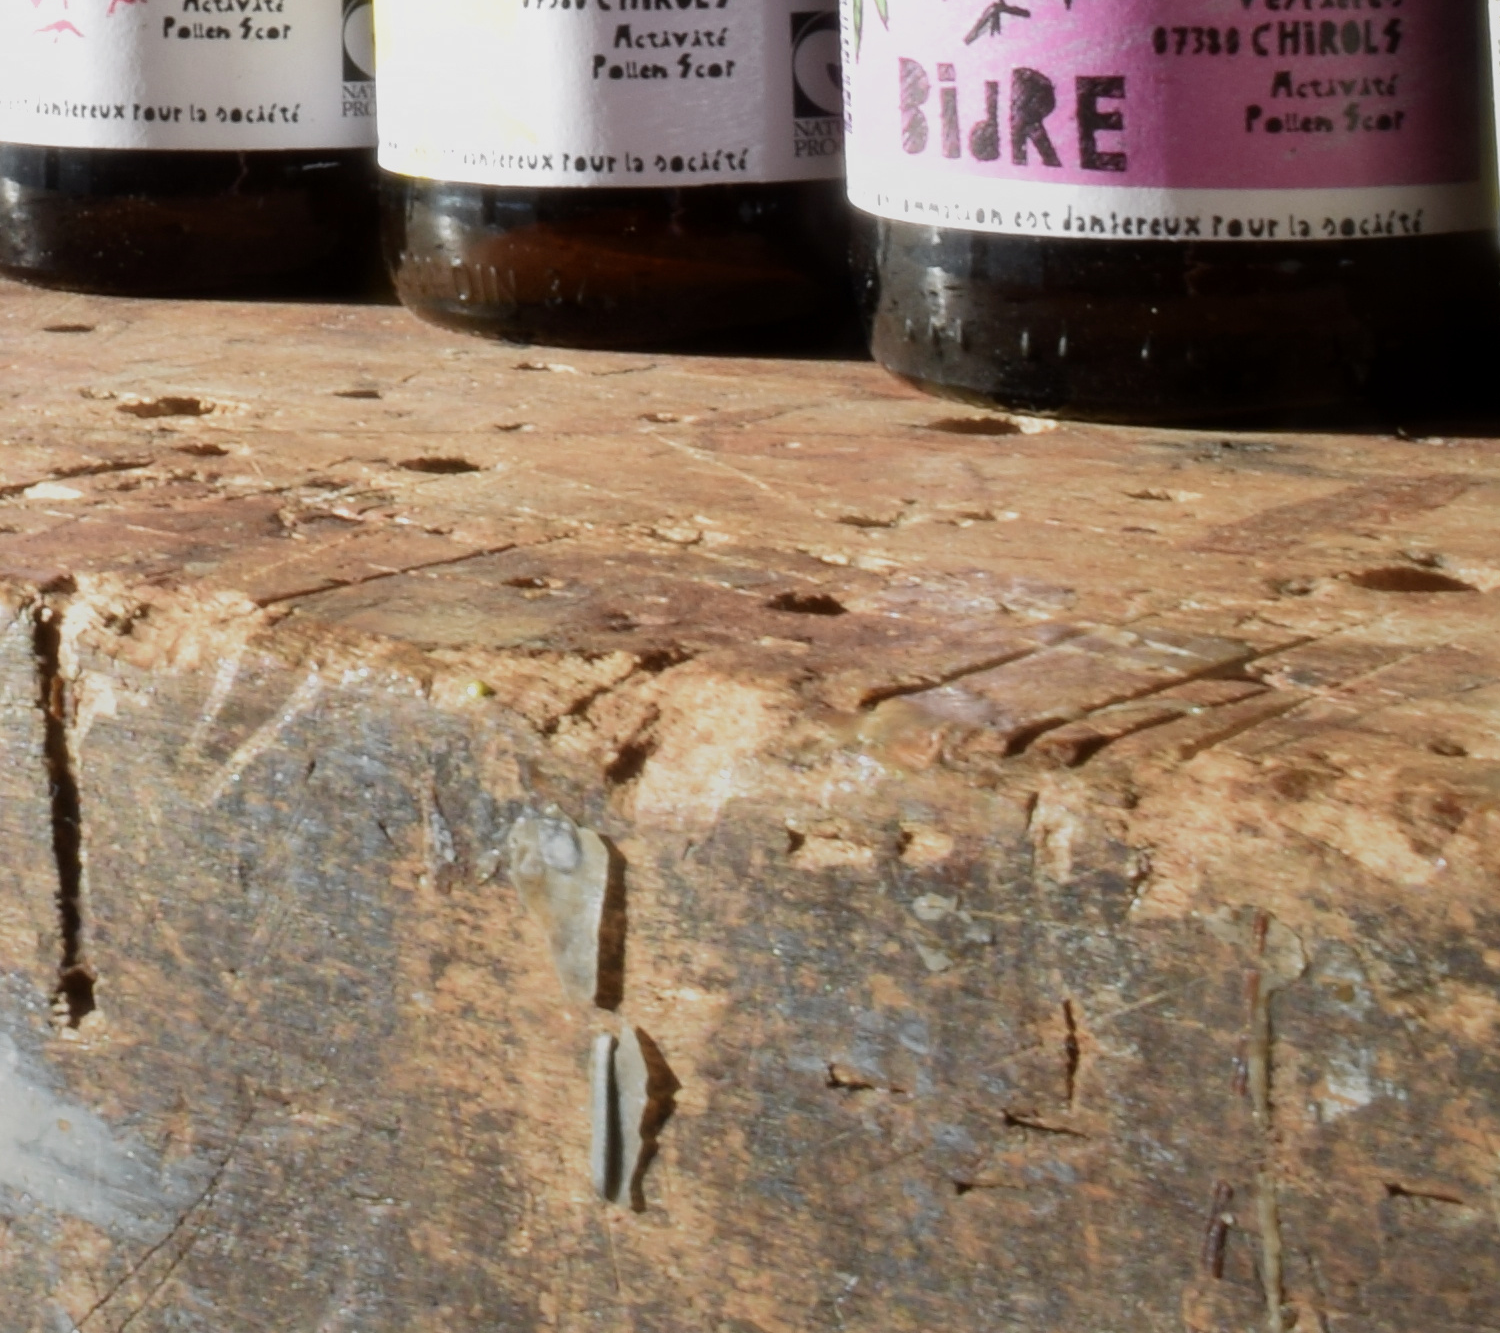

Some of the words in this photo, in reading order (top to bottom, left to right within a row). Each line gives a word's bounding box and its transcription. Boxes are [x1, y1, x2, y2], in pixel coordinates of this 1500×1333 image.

[163, 17, 230, 40] Pollen
[240, 17, 291, 40] Scop
[613, 24, 729, 50] Activité
[1153, 25, 1240, 56] 07380
[591, 54, 668, 80] Pollen
[677, 53, 737, 78] Scop
[1271, 71, 1398, 98] Activité
[133, 104, 182, 123] pour
[189, 103, 206, 123] la
[216, 101, 301, 123] société
[561, 150, 617, 174] pour
[625, 149, 647, 173] la
[654, 146, 751, 174] société
[1014, 210, 1051, 231] est
[1063, 205, 1200, 237] dangereux
[1212, 214, 1279, 237] pour
[1290, 214, 1310, 236] la
[1321, 209, 1424, 236] société
